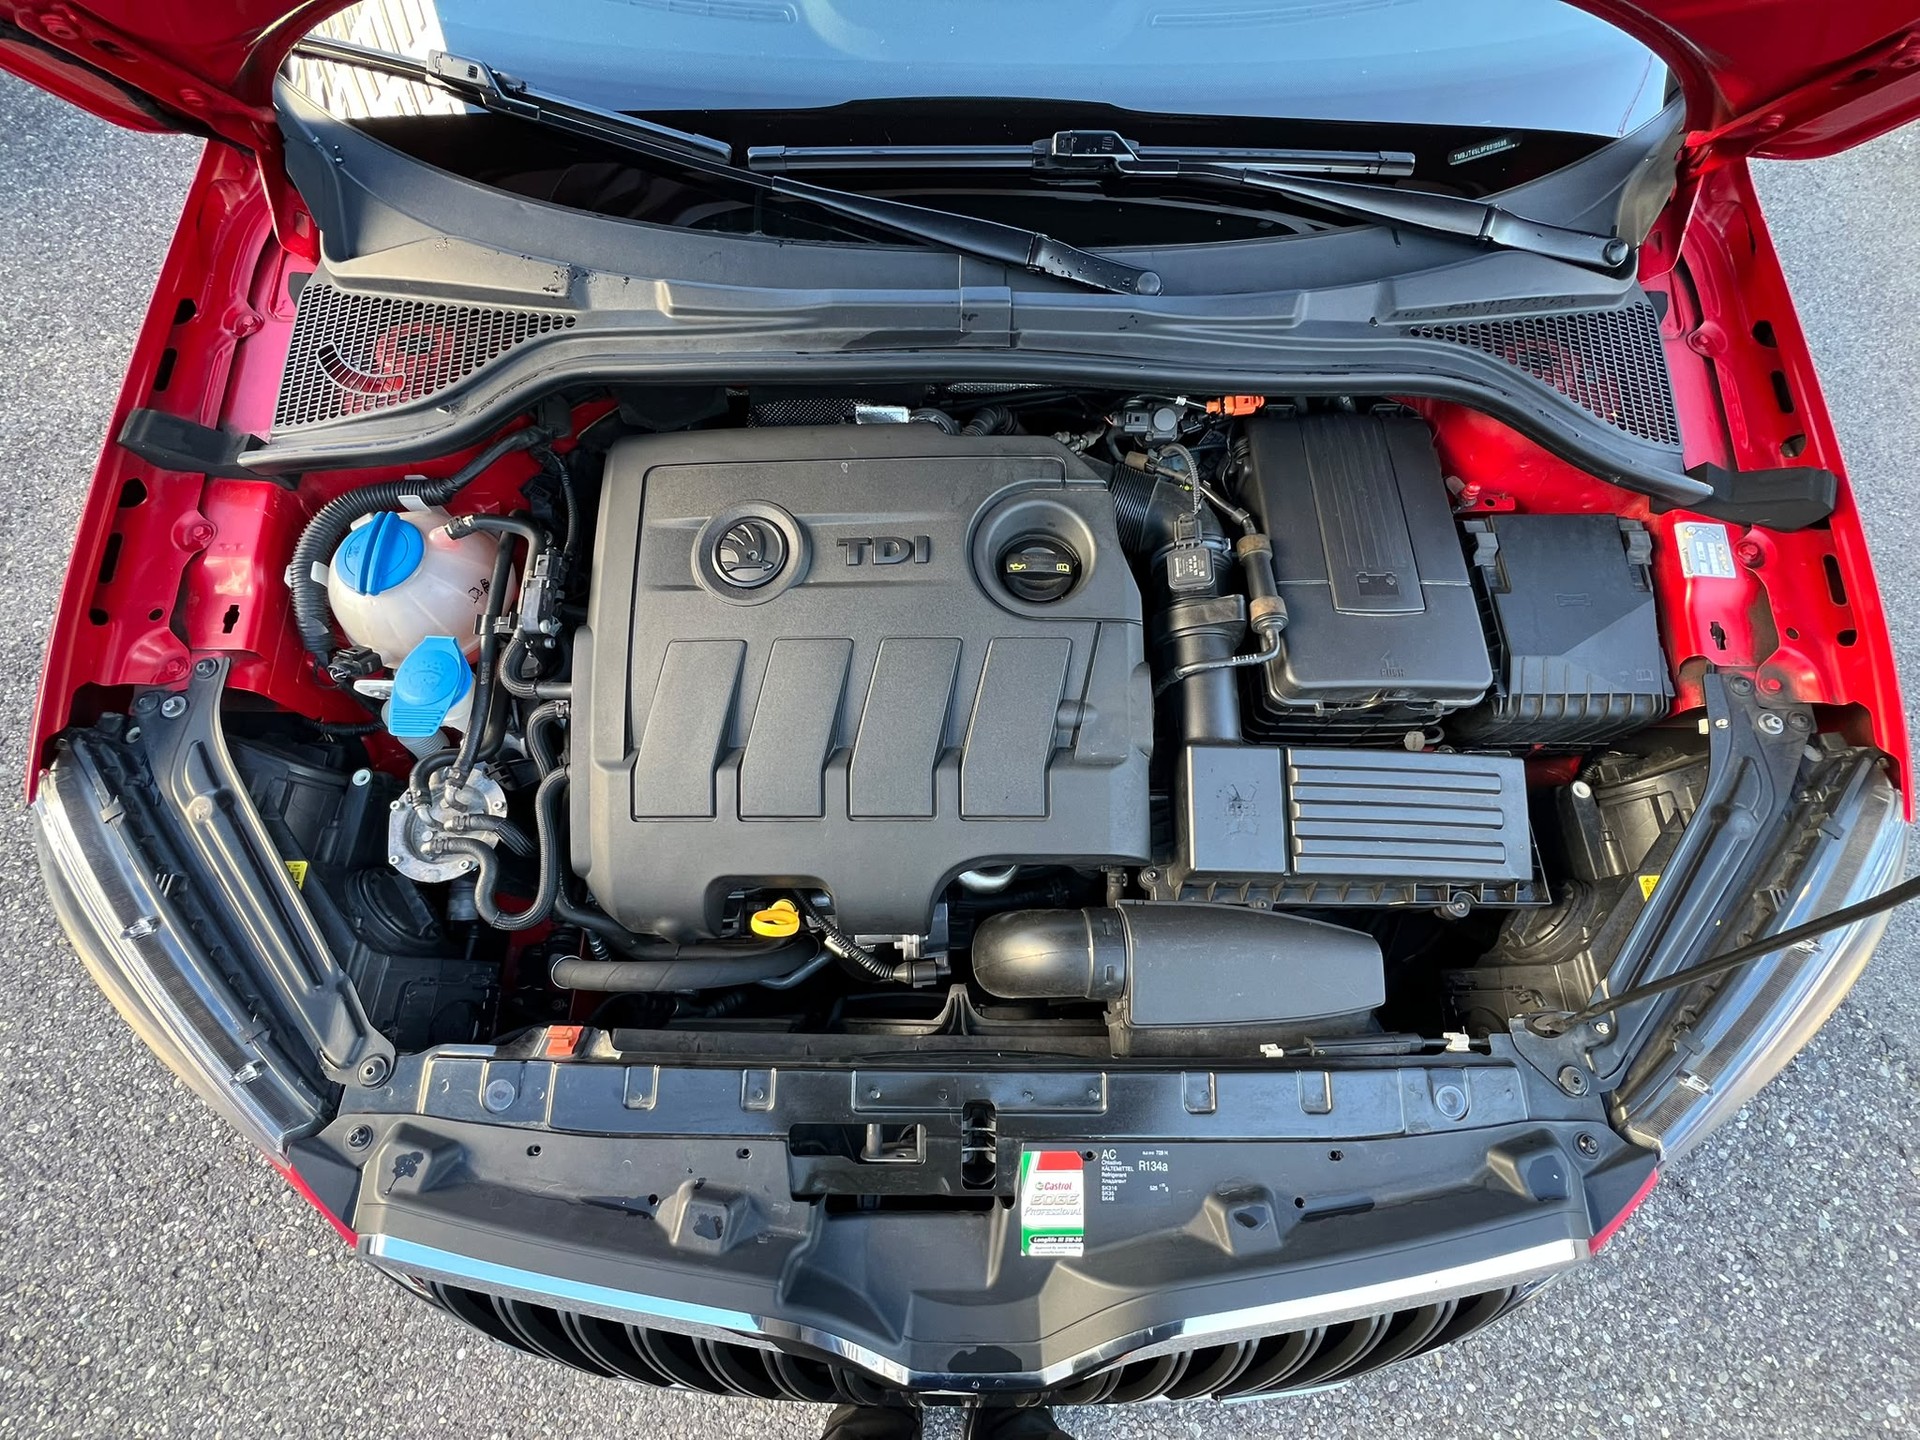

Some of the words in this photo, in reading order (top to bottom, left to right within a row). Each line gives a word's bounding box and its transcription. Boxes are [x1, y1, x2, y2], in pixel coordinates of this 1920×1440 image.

[837, 535, 930, 566] TDI
[1101, 1149, 1117, 1160] AC
[1138, 1160, 1169, 1172] R134a
[1044, 1182, 1072, 1191] Castrol
[1030, 1194, 1080, 1206] EDGE
